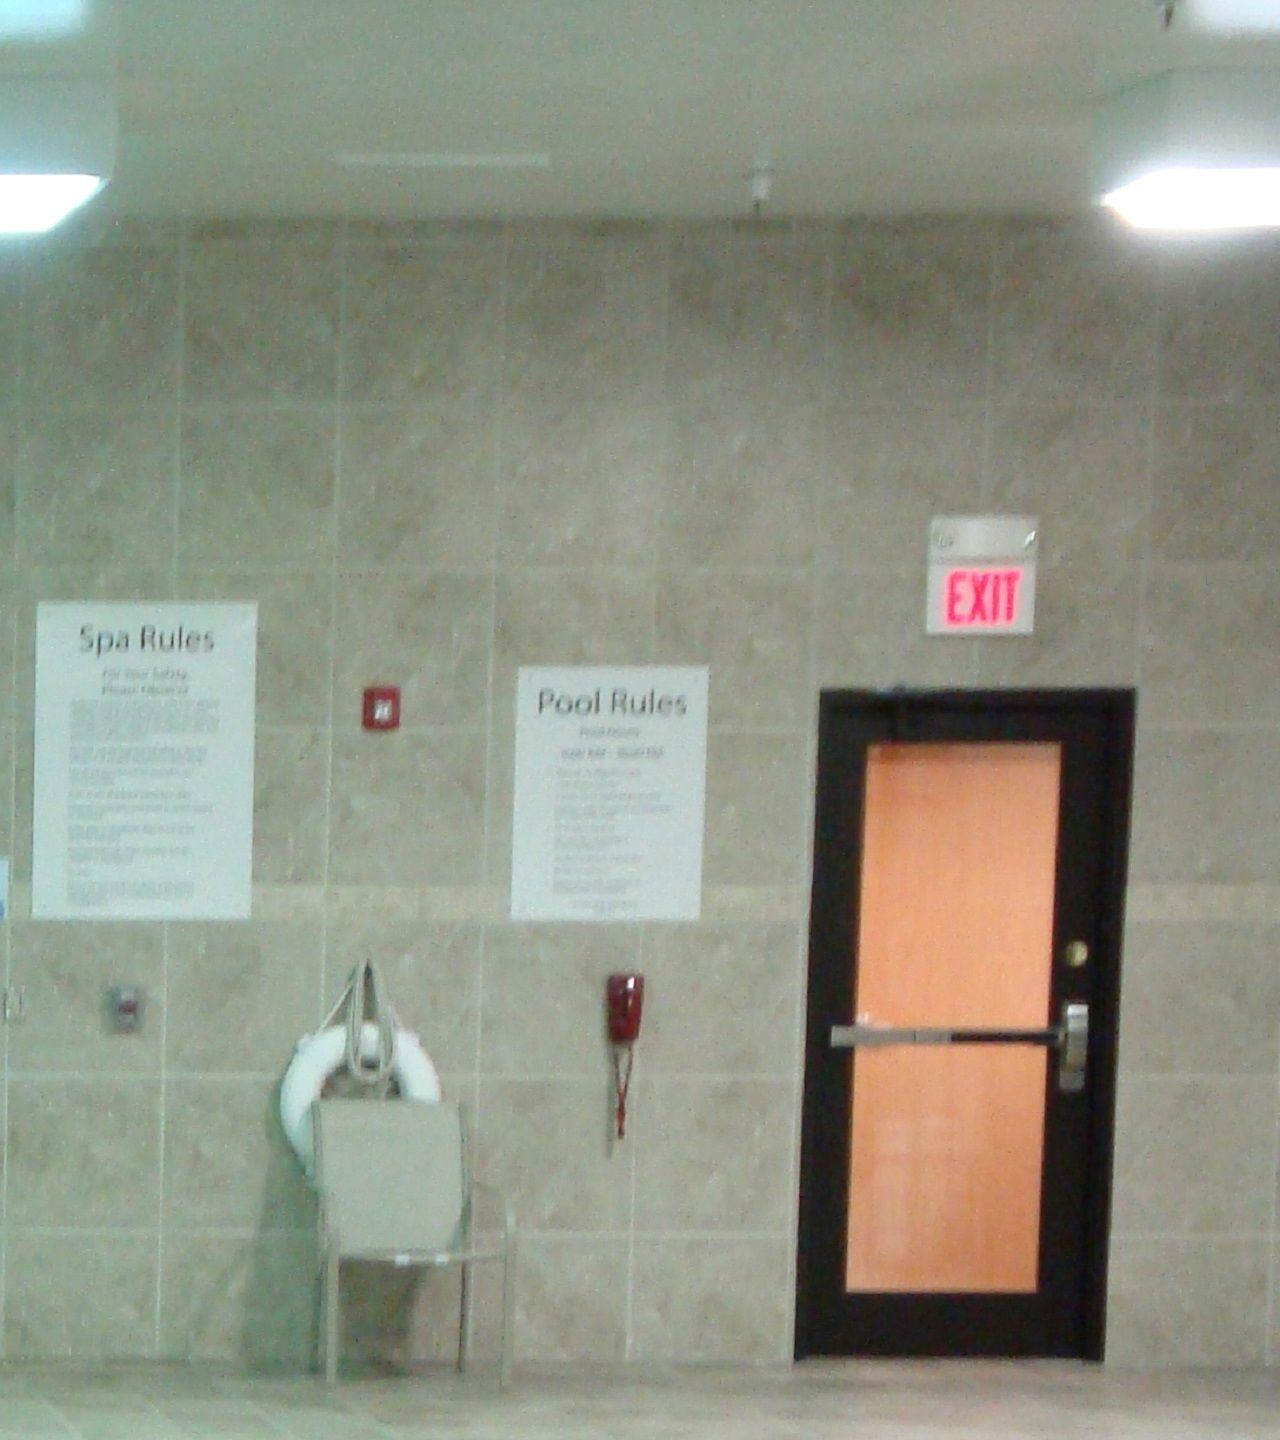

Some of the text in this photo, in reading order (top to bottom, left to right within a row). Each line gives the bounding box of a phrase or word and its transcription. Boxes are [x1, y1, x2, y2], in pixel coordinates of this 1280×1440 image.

[947, 570, 1021, 623] EXIT
[79, 624, 214, 658] Spa Rules
[540, 687, 687, 716] Pool Rules
